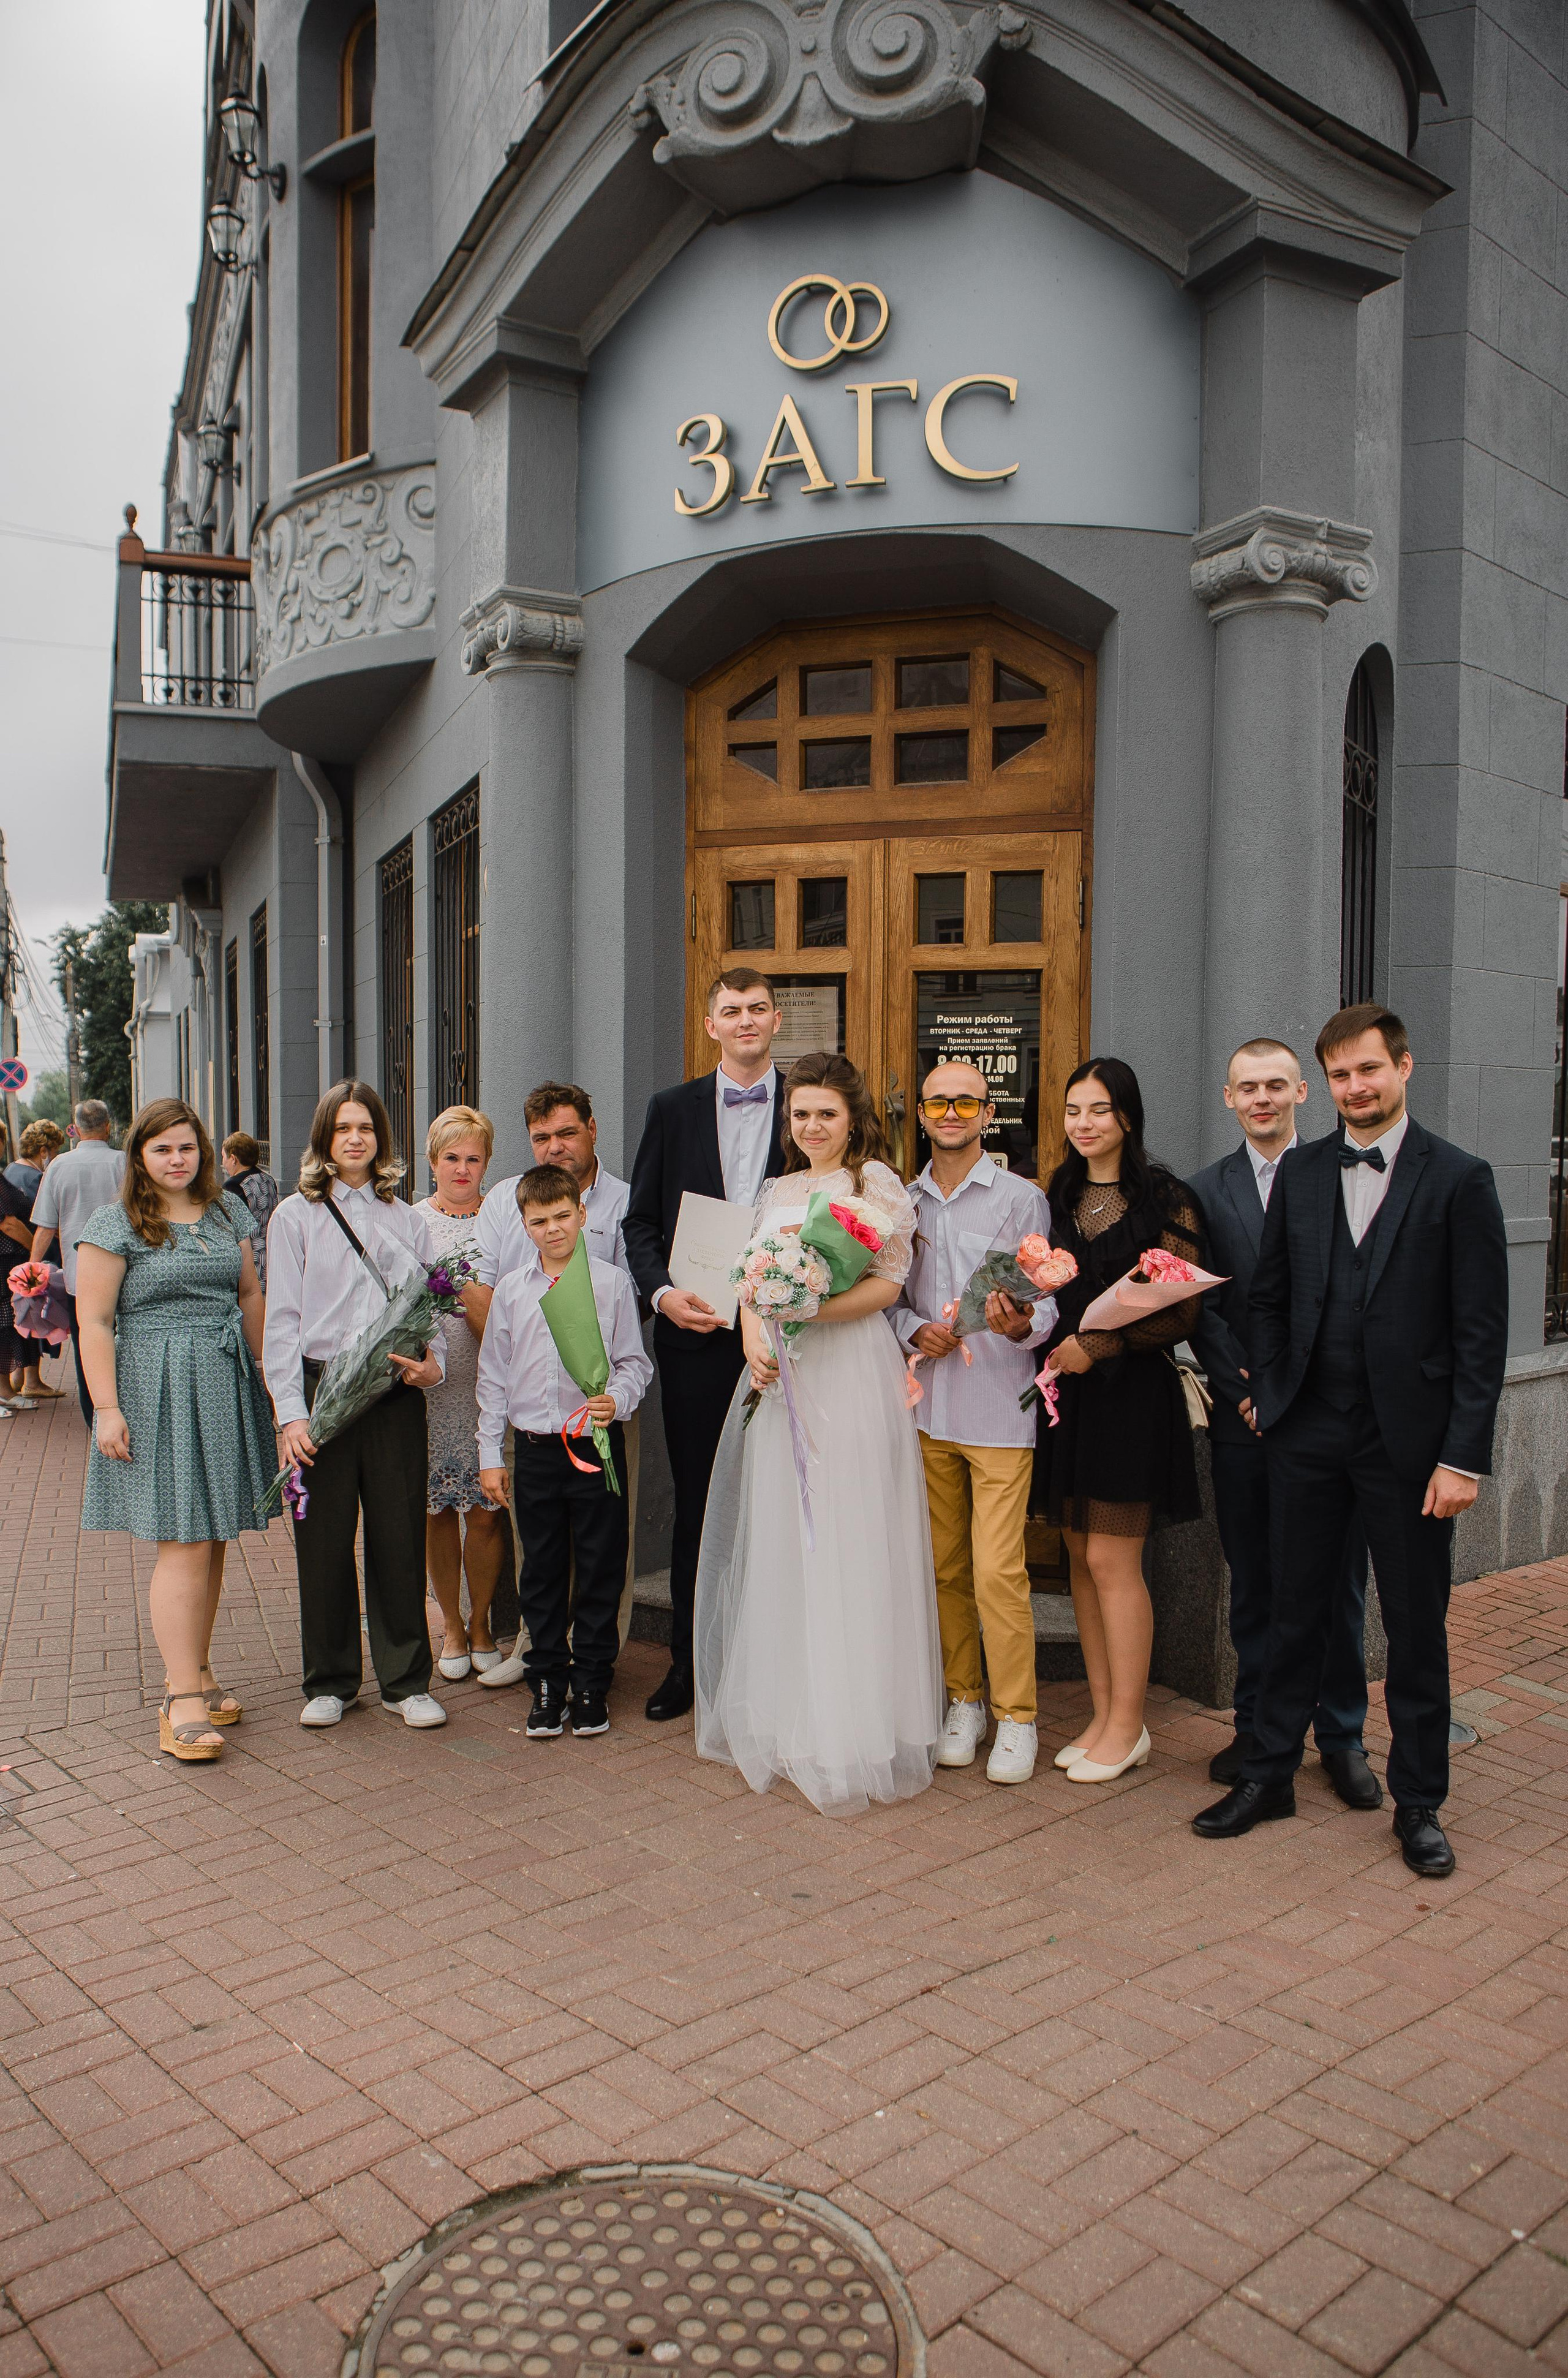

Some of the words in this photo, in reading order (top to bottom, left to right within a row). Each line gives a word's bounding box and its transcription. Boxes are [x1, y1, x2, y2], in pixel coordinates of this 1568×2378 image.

[674, 373, 1020, 518] ЗАГС
[937, 1014, 972, 1024] Режим
[974, 1014, 1012, 1025] работы
